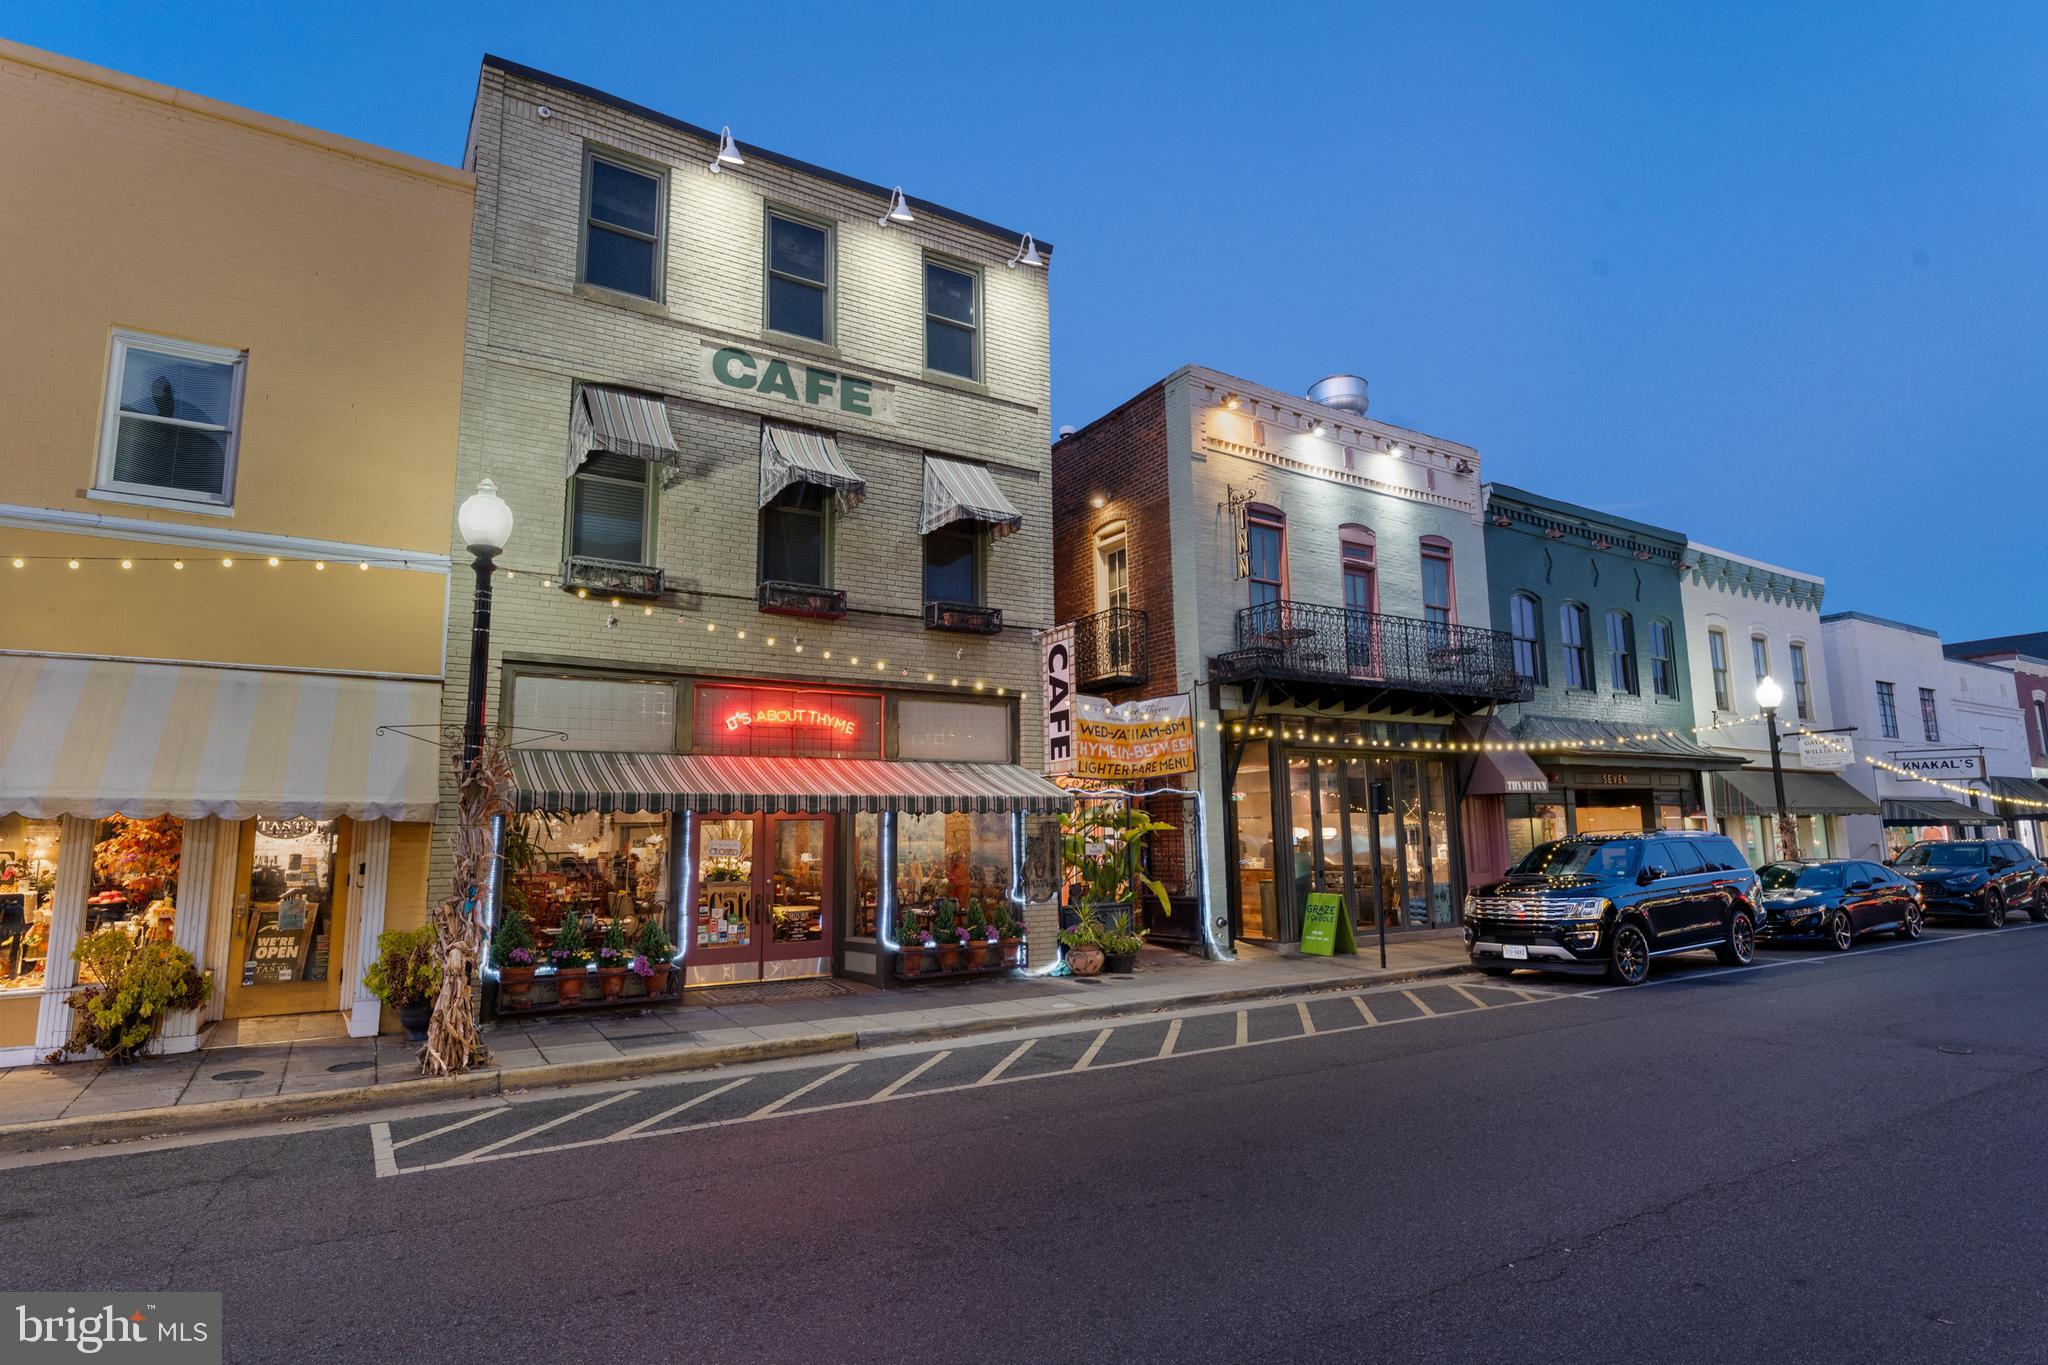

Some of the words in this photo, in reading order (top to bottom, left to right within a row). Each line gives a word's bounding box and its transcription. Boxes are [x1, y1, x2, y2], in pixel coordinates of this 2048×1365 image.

[712, 347, 872, 416] CAFE
[1048, 643, 1071, 761] CAFE
[756, 709, 806, 722] ABOUT
[807, 709, 856, 735] THYME
[1080, 723, 1130, 740] WED-SA
[1804, 738, 1845, 746] GAYHART
[1078, 761, 1131, 775] LIGHTER
[1131, 761, 1158, 775] FARE
[1159, 757, 1189, 771] MENU
[1902, 759, 1974, 770] KNAKAL'S
[1602, 774, 1629, 784] SEVEN
[259, 821, 315, 832] TASTE
[1306, 904, 1336, 916] GRAZE
[257, 937, 295, 947] WE'RE
[255, 946, 299, 959] OPEN
[255, 965, 289, 974] TASTE
